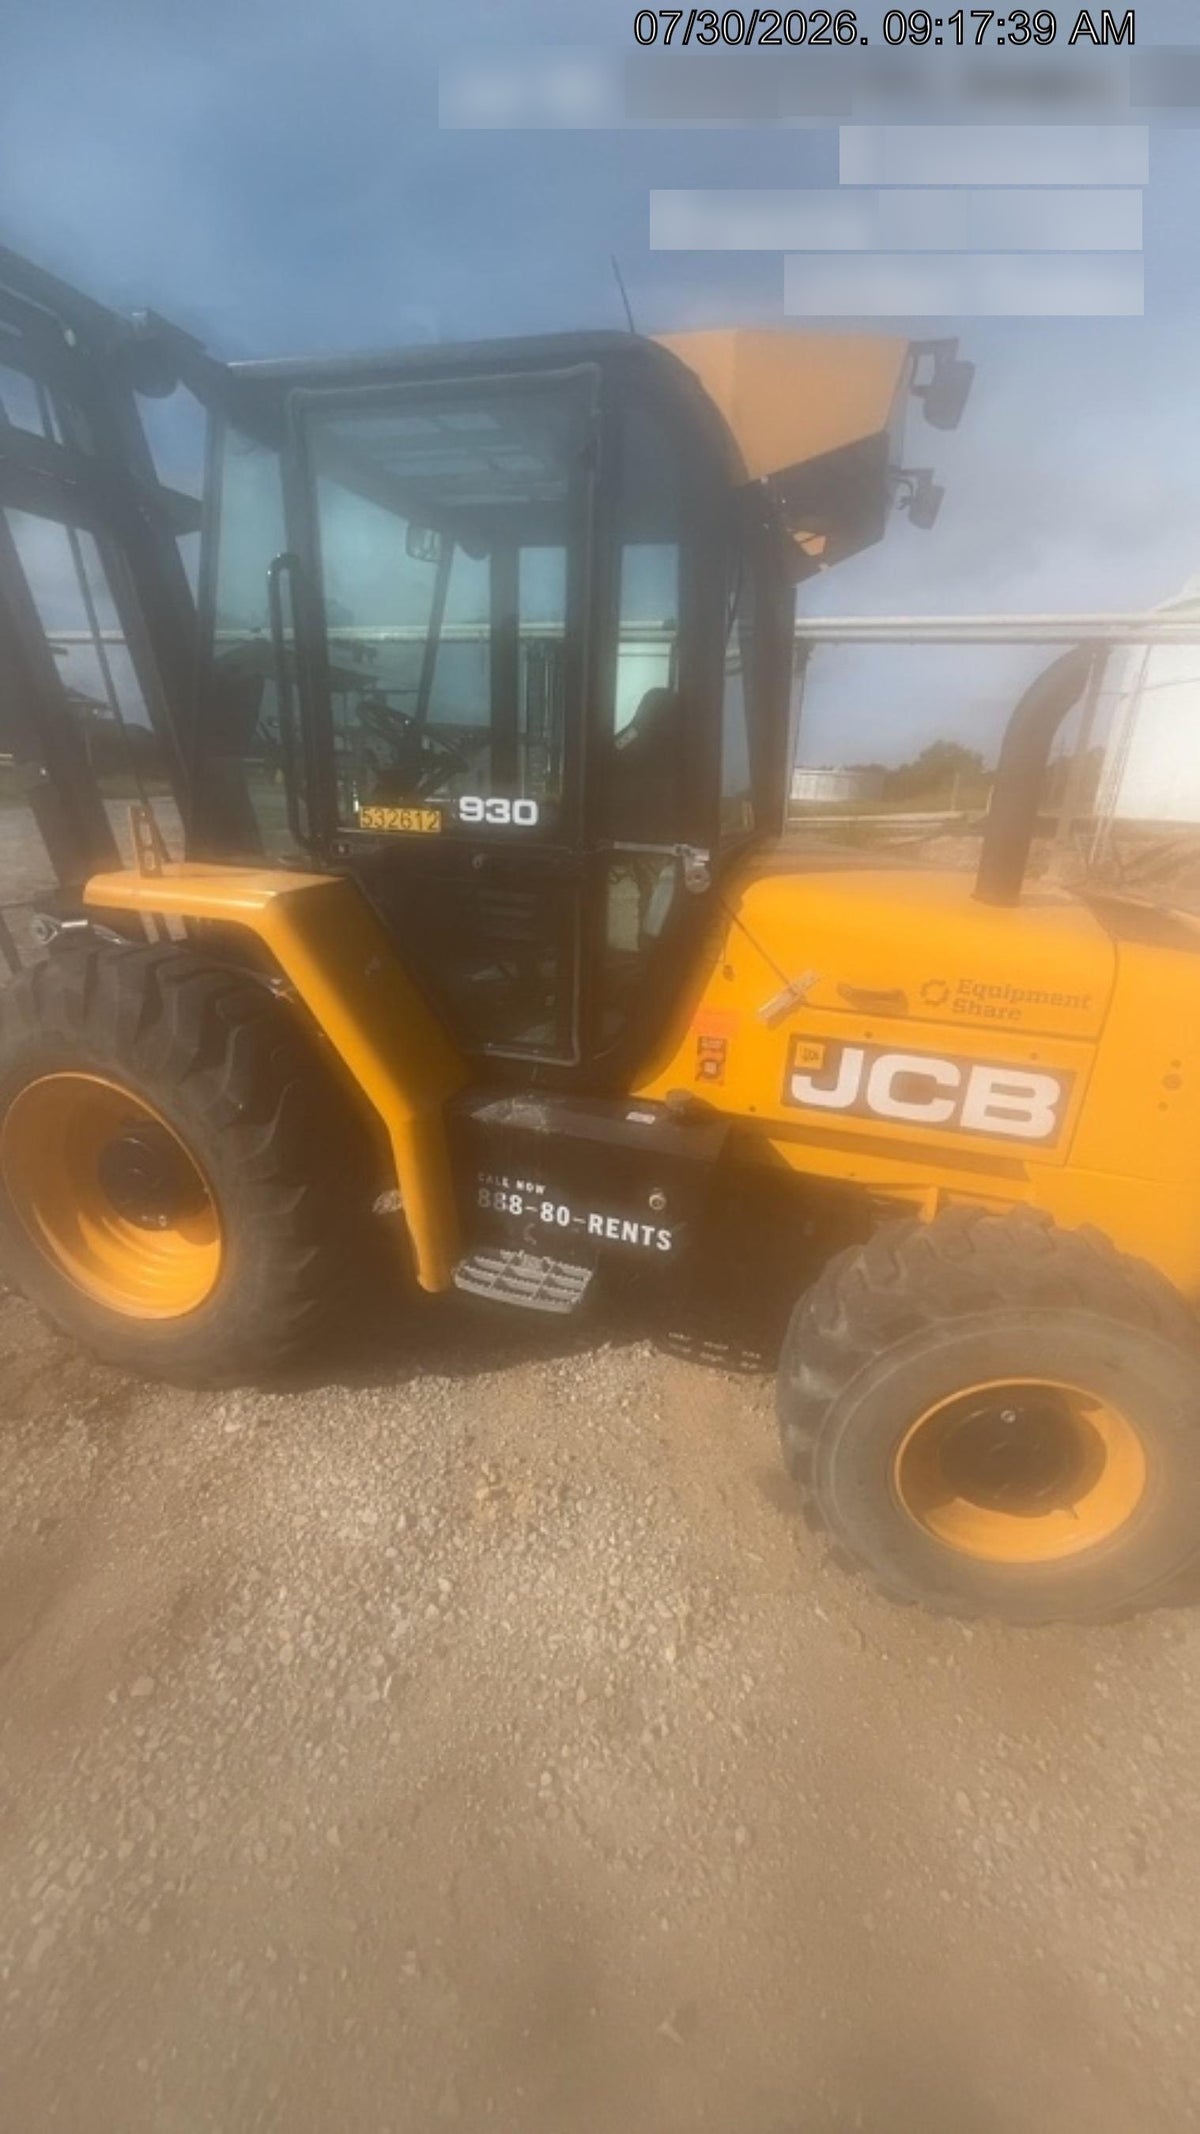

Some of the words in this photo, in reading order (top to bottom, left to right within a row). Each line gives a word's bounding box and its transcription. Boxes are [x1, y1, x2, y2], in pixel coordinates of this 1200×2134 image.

[361, 807, 440, 831] 532612
[459, 796, 538, 826] 930
[957, 978, 1092, 1009] Equipment
[952, 998, 1023, 1022] Share
[791, 1047, 1061, 1139] JCB
[516, 1179, 546, 1195] NOW
[478, 1187, 672, 1250] 888-80-RENTS
